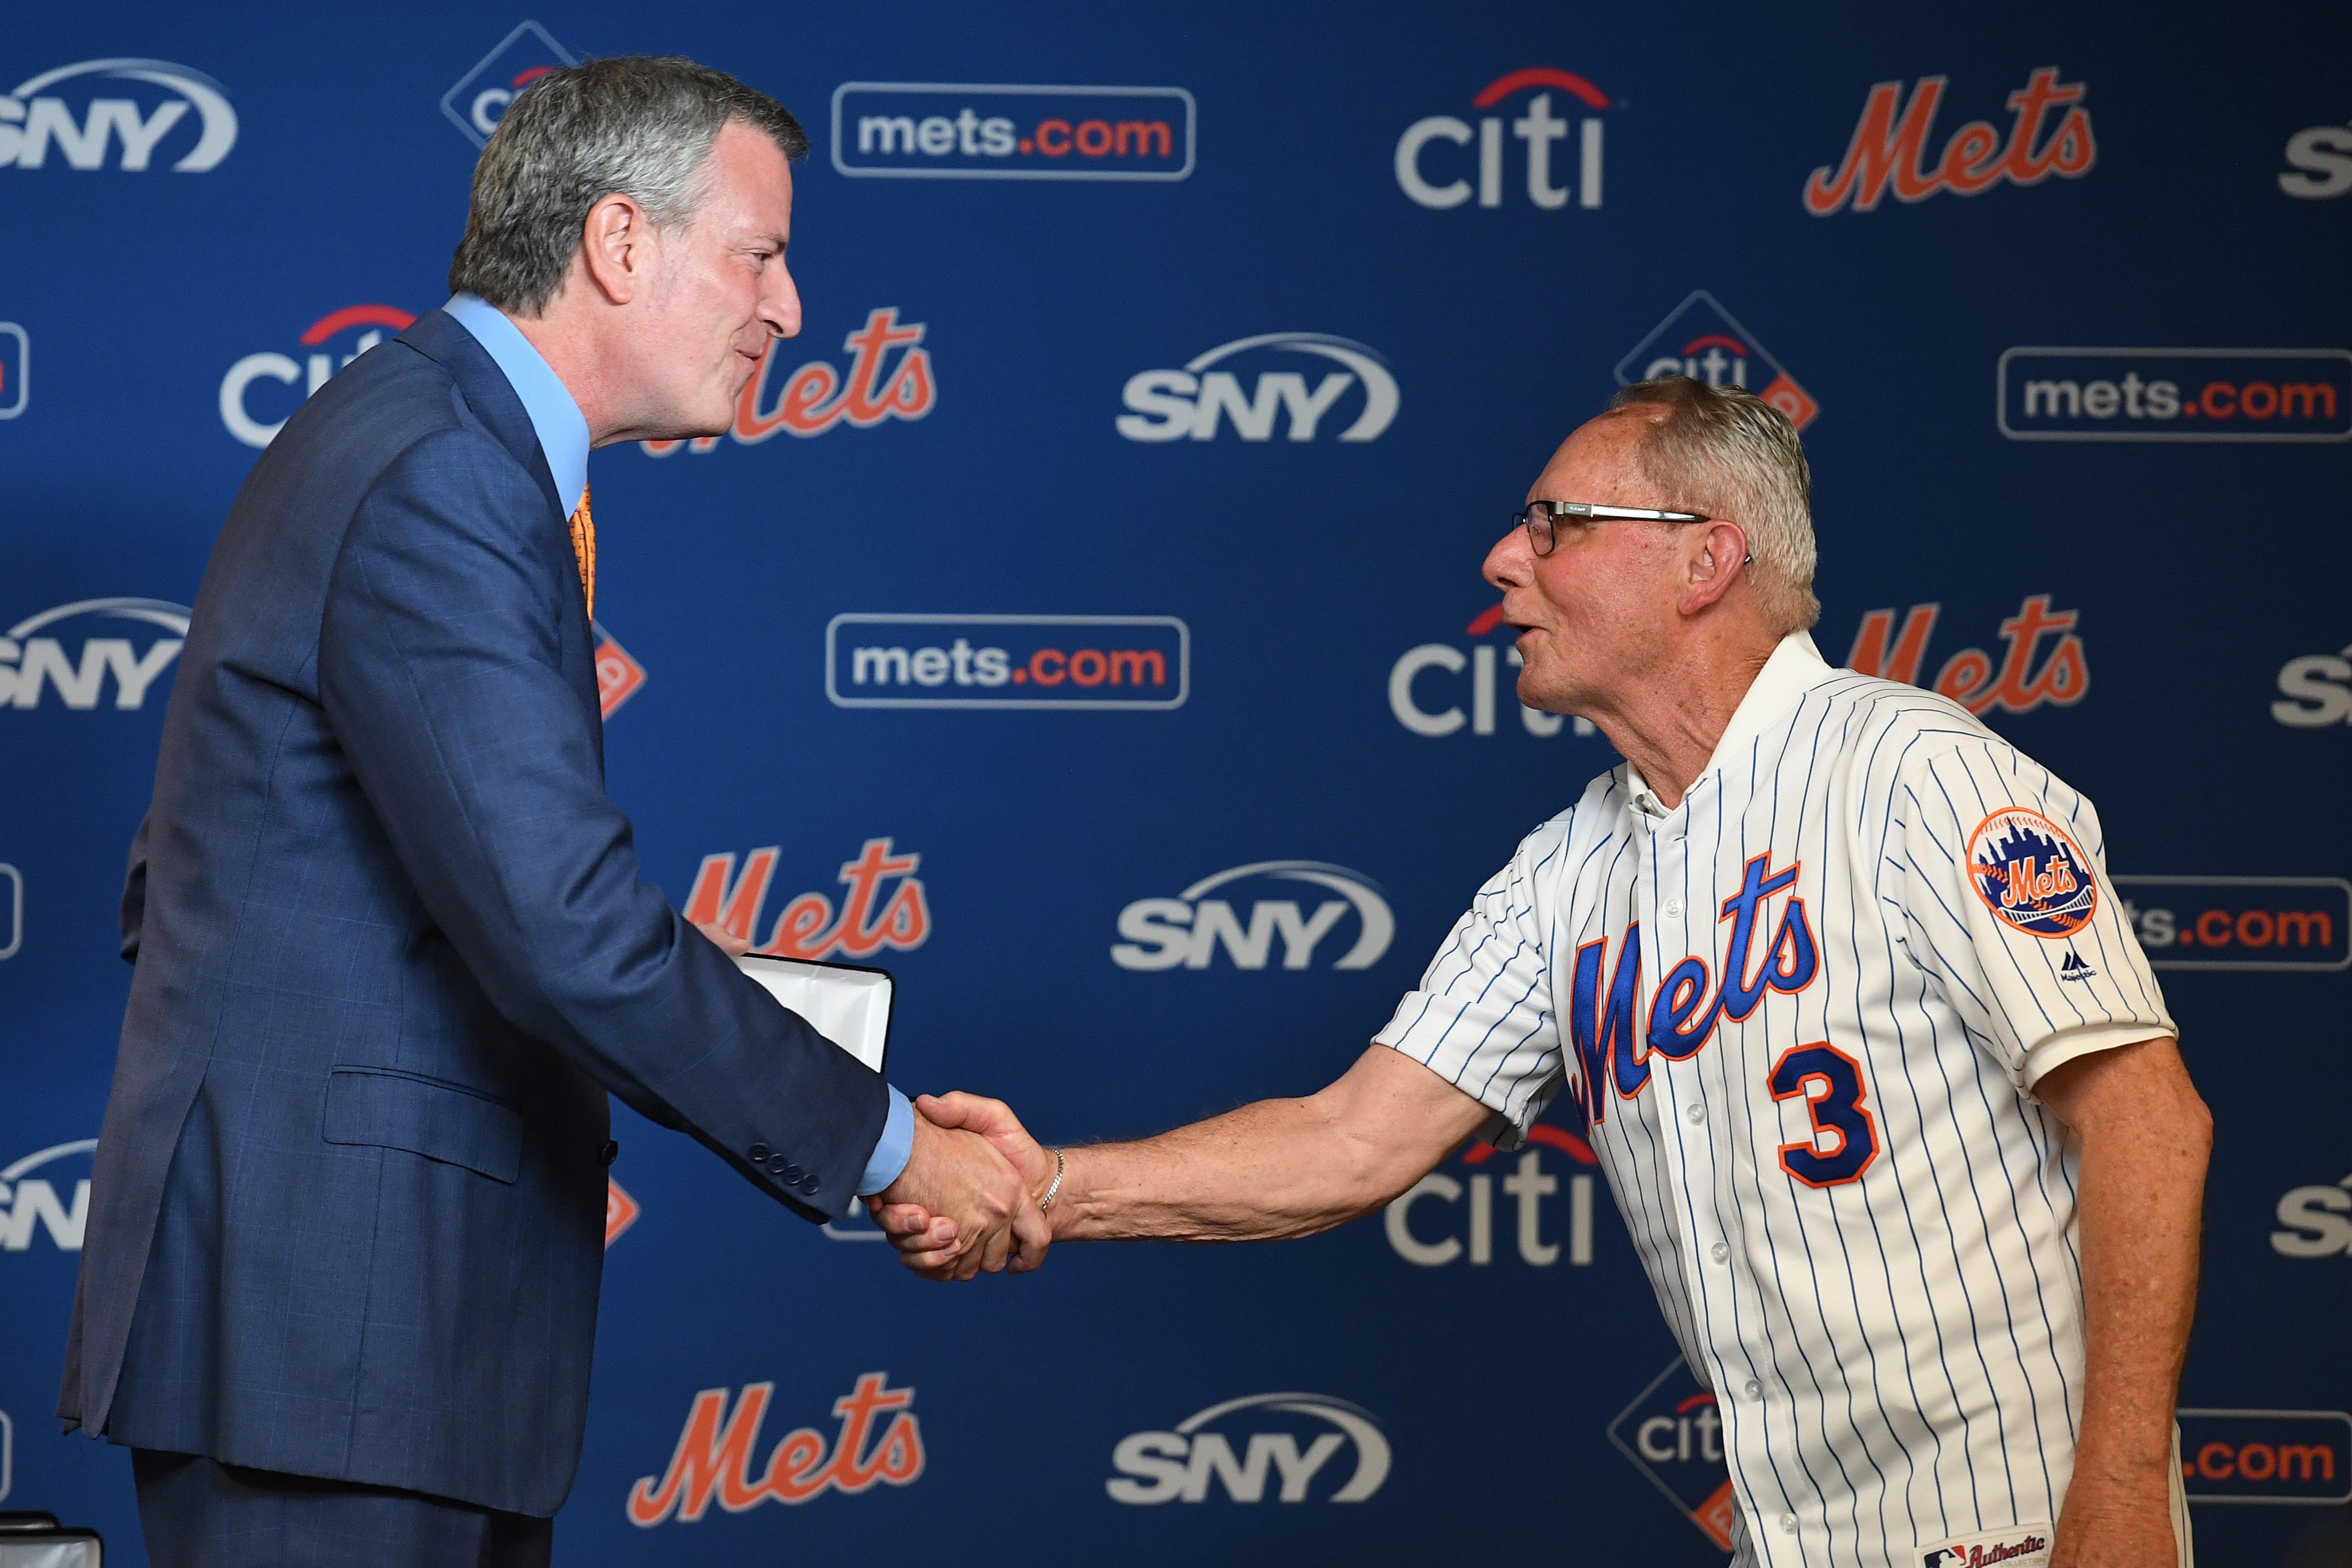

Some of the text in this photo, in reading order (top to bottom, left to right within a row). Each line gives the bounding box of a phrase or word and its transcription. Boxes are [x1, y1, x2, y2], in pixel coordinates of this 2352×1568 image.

[858, 106, 1173, 157] mets.com
[1394, 92, 1604, 209] citi
[1803, 67, 2096, 216] Mets
[1115, 368, 1355, 442] SNY
[2024, 371, 2337, 419] mets.com
[0, 636, 185, 709] NY
[852, 638, 1166, 687] mets.com
[1388, 643, 1595, 738] ci
[2001, 855, 2077, 908] Mets
[1111, 898, 1349, 971] SNY
[2123, 899, 2333, 948] s.com
[1569, 849, 1820, 1136] Mets
[1766, 1041, 1880, 1189] 3
[1384, 1149, 1593, 1266] citi
[627, 1371, 926, 1528] Mets
[1105, 1430, 1346, 1505] SNY
[1637, 1406, 1723, 1462] cit
[2183, 1442, 2334, 1481] .com
[1965, 1535, 2045, 1568] Authentic
